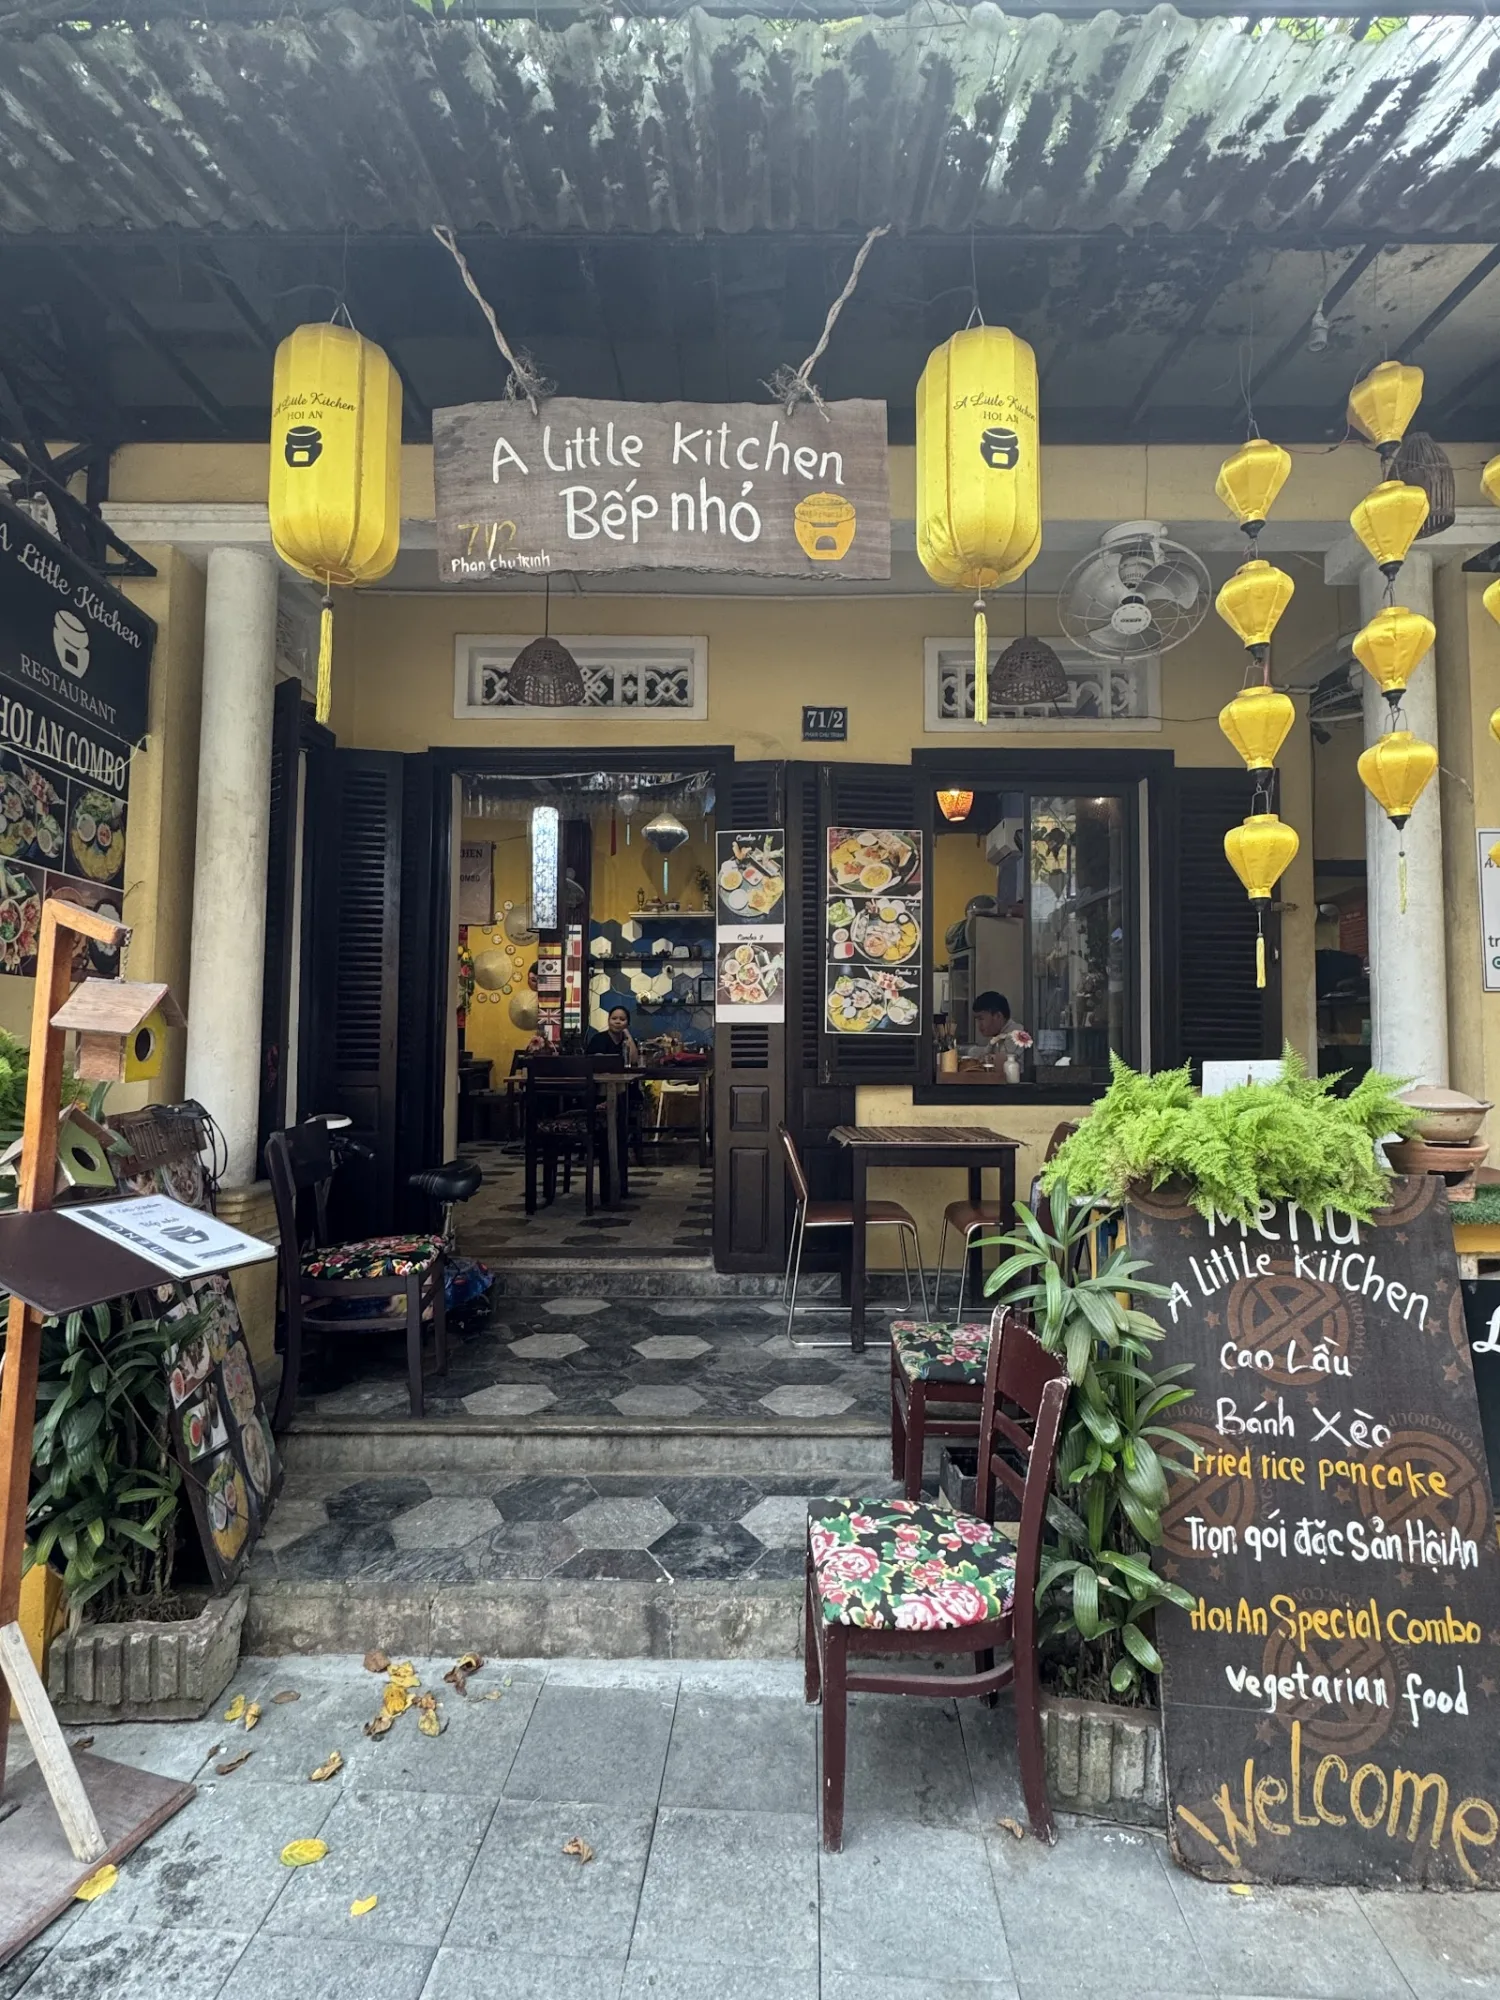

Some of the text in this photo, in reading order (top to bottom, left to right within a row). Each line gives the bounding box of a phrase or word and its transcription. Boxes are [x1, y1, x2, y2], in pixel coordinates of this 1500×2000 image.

[287, 411, 323, 420] HOI AN
[310, 392, 356, 412] Kitchen
[953, 396, 969, 410] A
[970, 392, 1005, 407] Little
[492, 421, 845, 485] A Little Kitchen
[559, 478, 659, 543] Bếp
[451, 557, 486, 573] Phan
[17, 543, 71, 595] Little
[74, 585, 142, 649] Kitchen
[20, 653, 117, 724] RESTAURANT
[807, 710, 844, 729] 71/2
[36, 716, 64, 763] AN
[66, 731, 126, 792] COMBO
[460, 848, 483, 858] HEN
[1168, 1281, 1192, 1324] A
[1220, 1336, 1352, 1376] Cao Lầu
[1215, 1396, 1392, 1449] Bánh Xèo
[1261, 1451, 1305, 1484] rice
[1319, 1460, 1453, 1499] pancake
[1184, 1516, 1238, 1559] Trọn
[1294, 1519, 1344, 1564] đặc
[1346, 1516, 1403, 1562] Sản
[1270, 1594, 1381, 1652] Special
[1386, 1606, 1482, 1645] Combo
[1401, 1665, 1469, 1728] food
